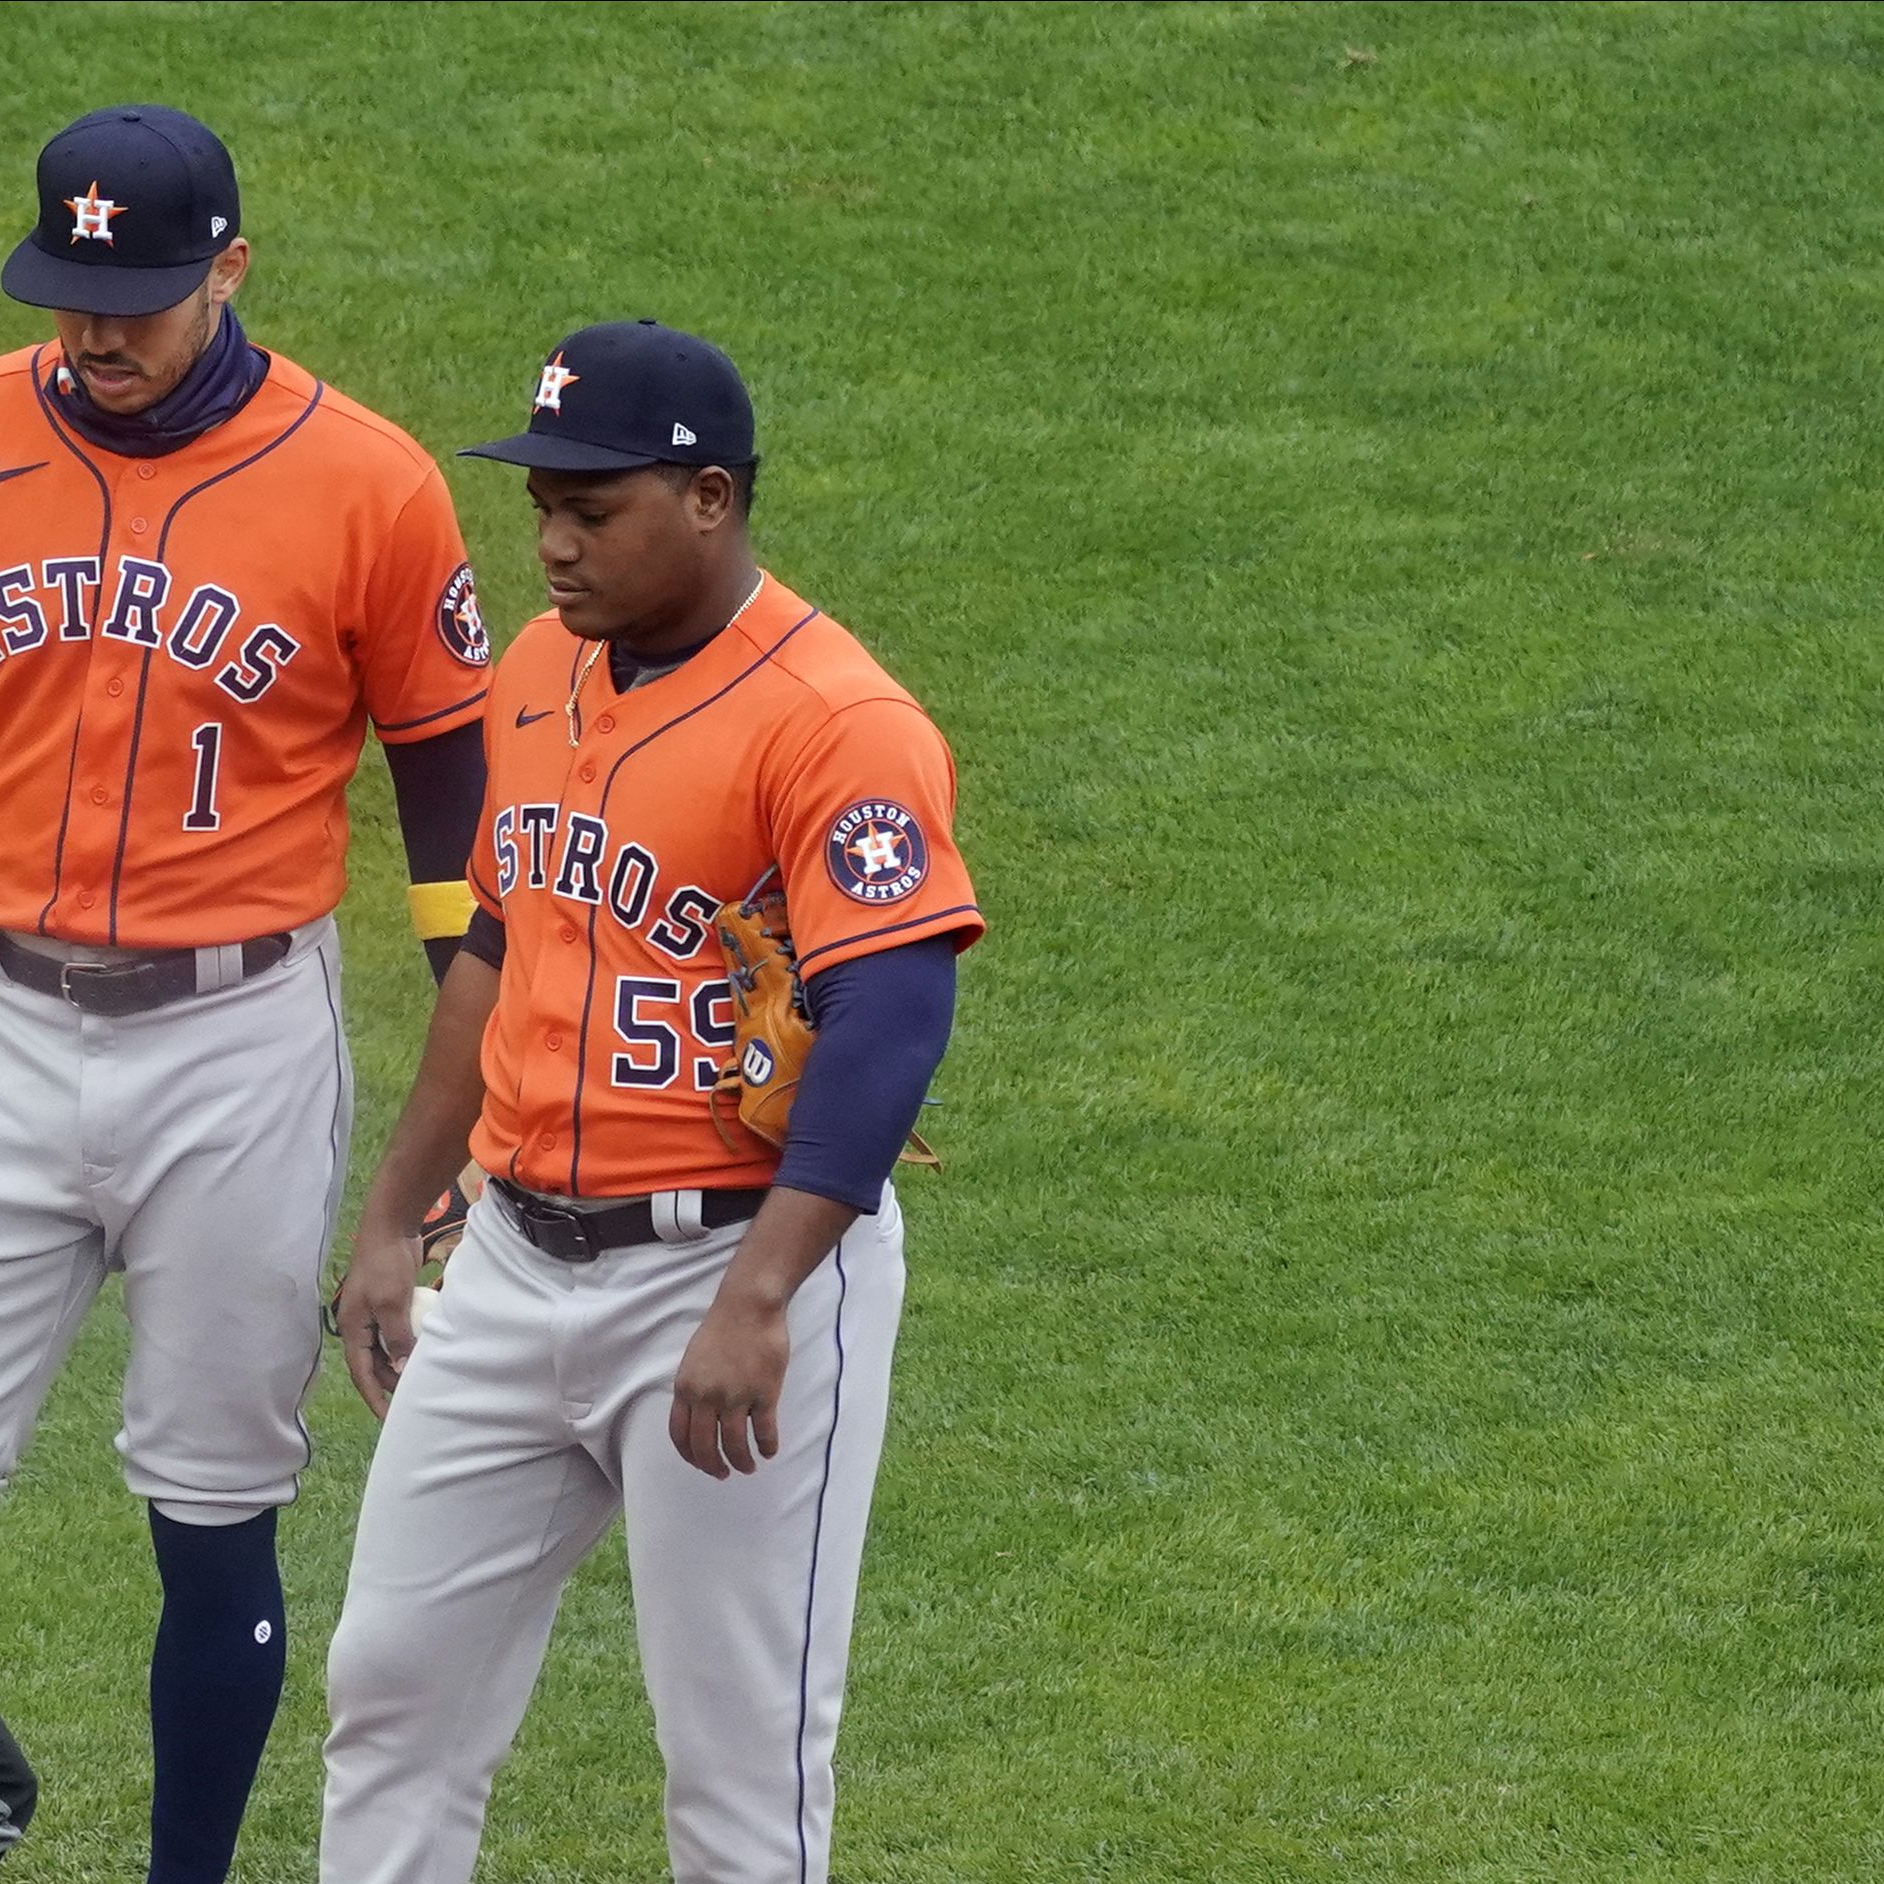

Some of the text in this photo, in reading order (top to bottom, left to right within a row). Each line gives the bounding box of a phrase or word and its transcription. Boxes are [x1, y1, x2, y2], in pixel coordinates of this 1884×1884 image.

[183, 722, 222, 831] 1
[833, 804, 910, 844] HOUSTON
[493, 803, 725, 960] STROS
[851, 866, 921, 898] ASTROS
